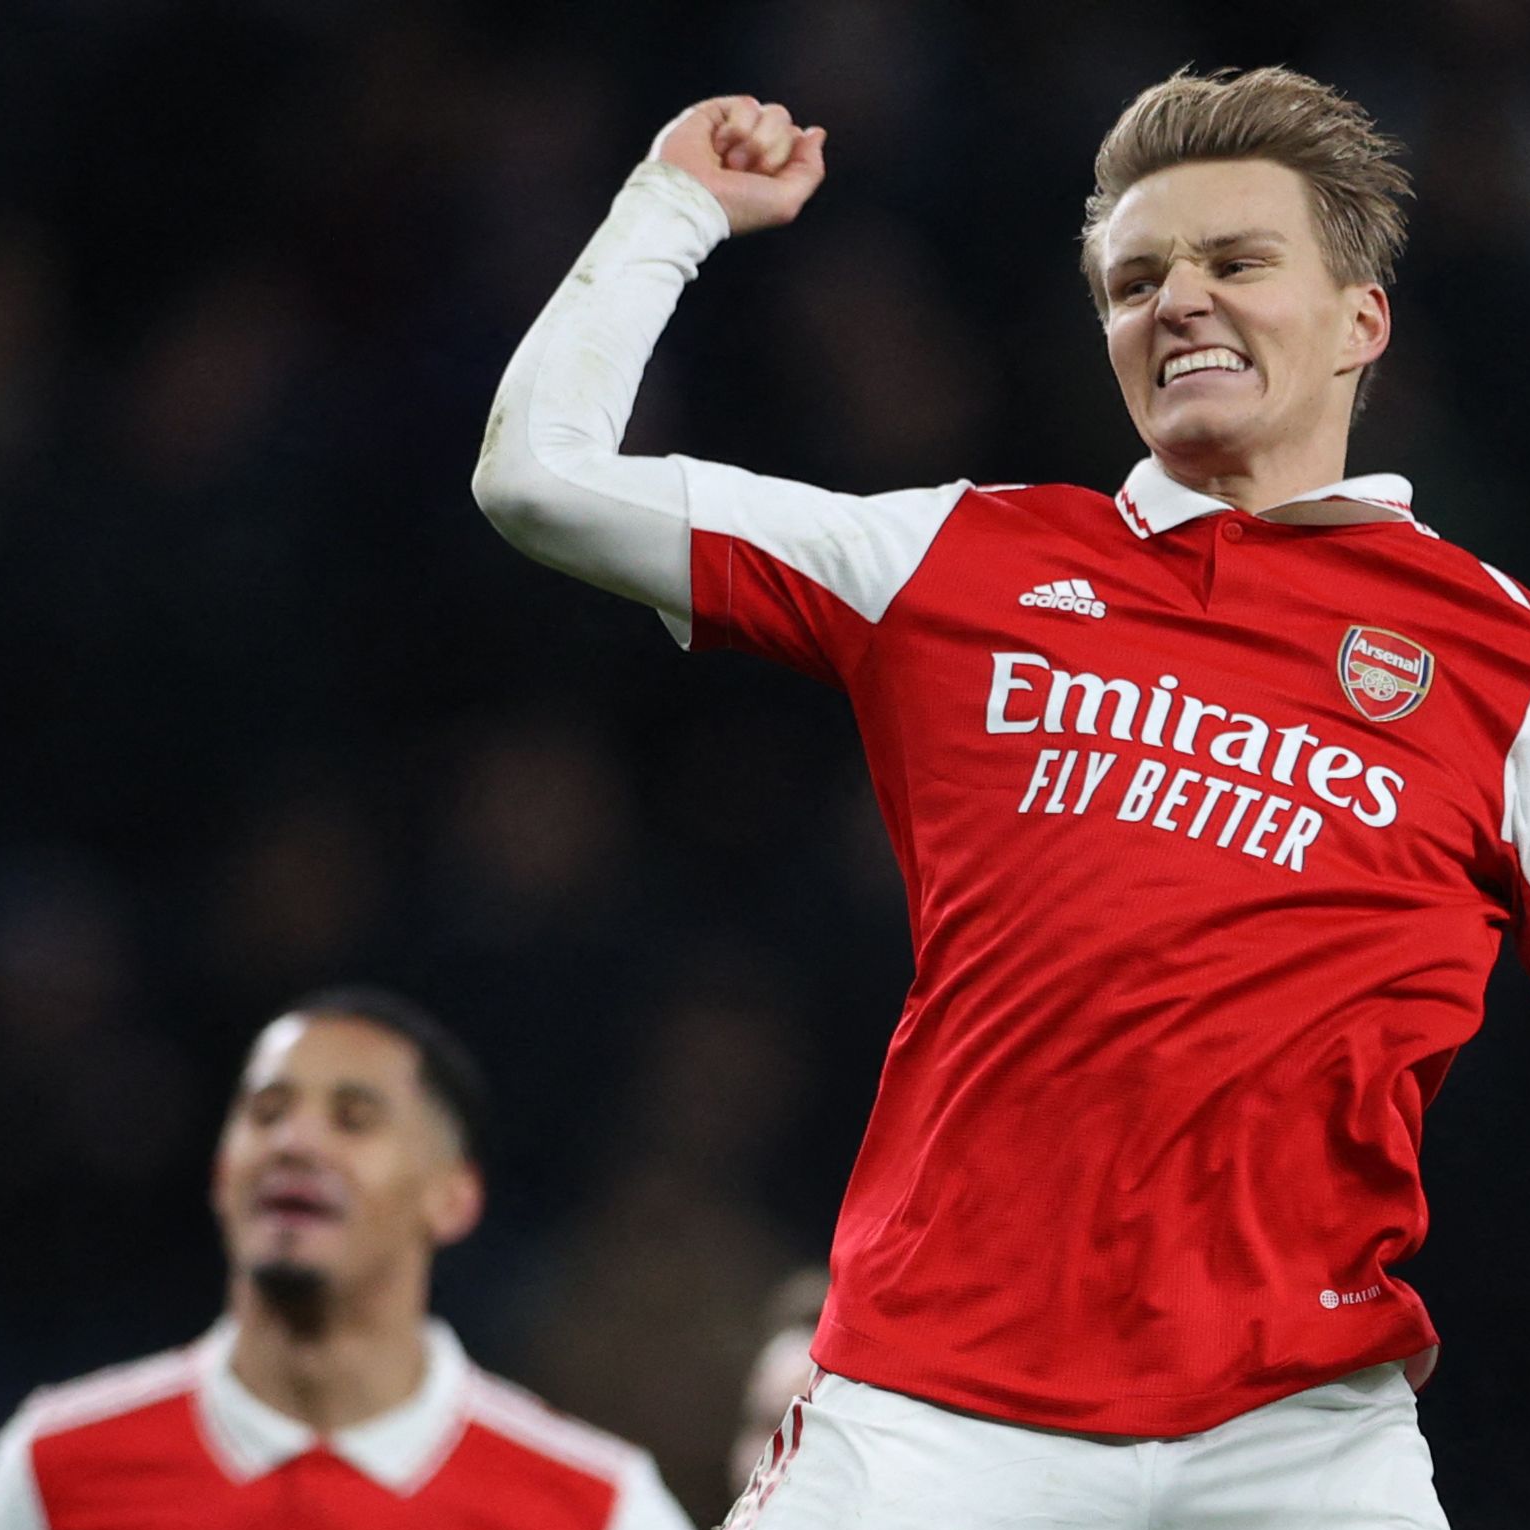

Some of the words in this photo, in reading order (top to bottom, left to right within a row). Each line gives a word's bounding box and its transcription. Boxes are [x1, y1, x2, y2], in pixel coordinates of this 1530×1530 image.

[1019, 591, 1107, 619] adidas
[1353, 637, 1421, 675] Arsenal
[985, 651, 1406, 829] Emirates
[1017, 748, 1118, 815] FLY
[1115, 758, 1324, 873] BETTER
